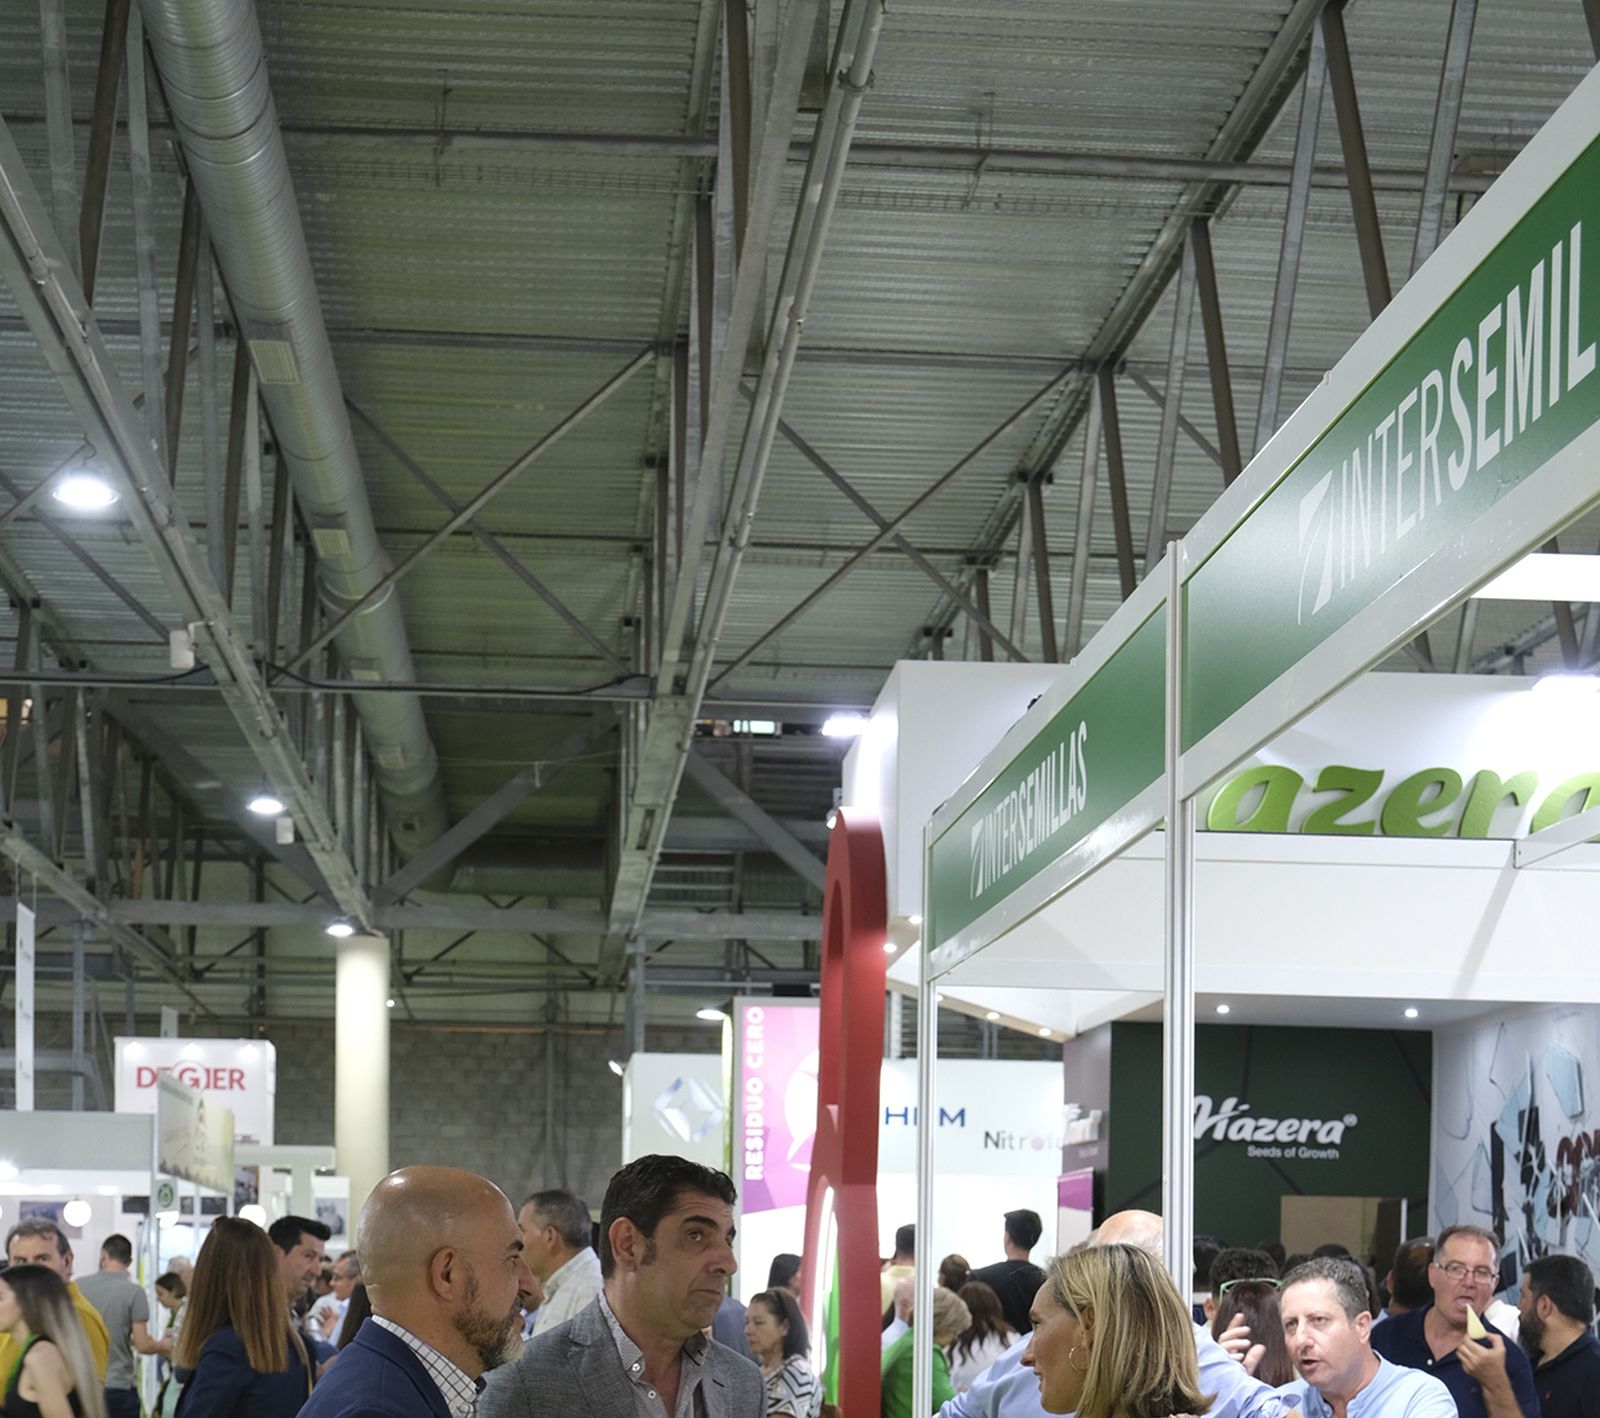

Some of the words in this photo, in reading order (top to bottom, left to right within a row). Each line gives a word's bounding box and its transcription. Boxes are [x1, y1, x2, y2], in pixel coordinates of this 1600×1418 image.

[983, 719, 1088, 890] INTERSEMILLAS
[745, 1006, 766, 1070] CERO
[136, 1066, 247, 1091] DGIER
[745, 1076, 765, 1181] RESIDUO
[1247, 1144, 1282, 1158] Seeds
[1283, 1146, 1297, 1159] of
[1298, 1146, 1340, 1160] Growth
